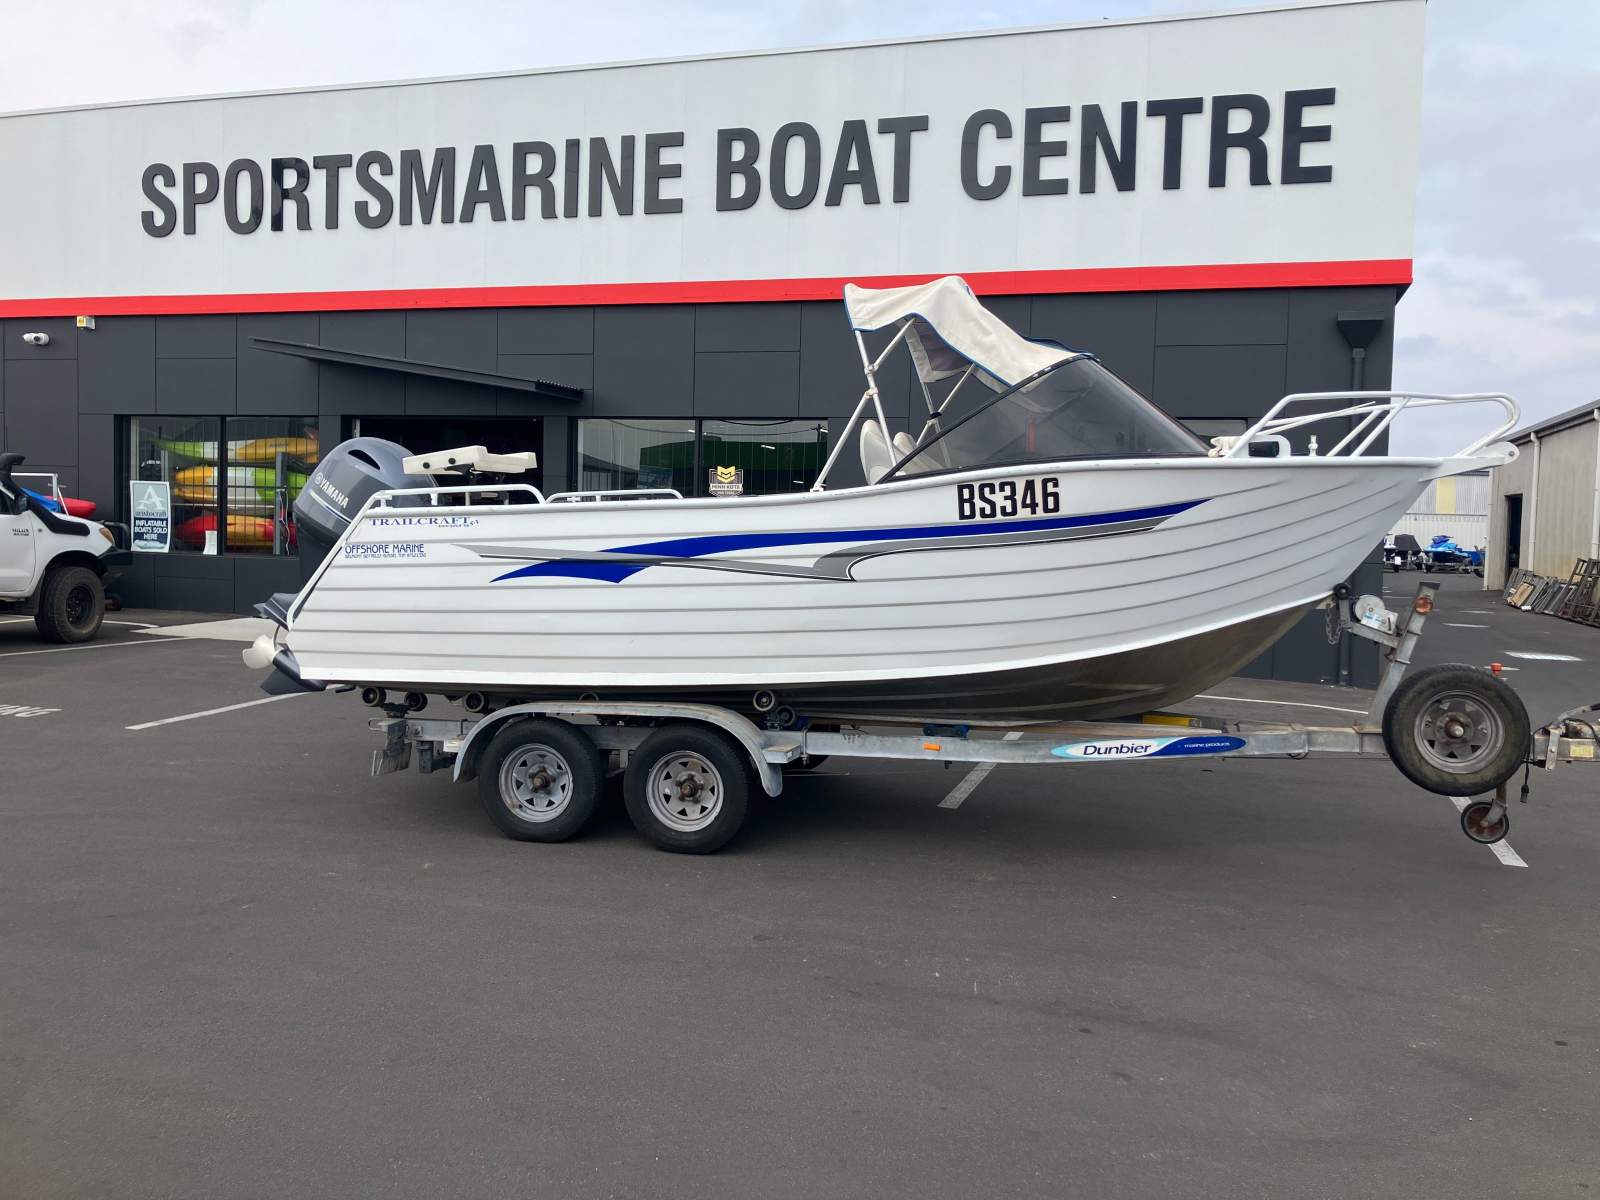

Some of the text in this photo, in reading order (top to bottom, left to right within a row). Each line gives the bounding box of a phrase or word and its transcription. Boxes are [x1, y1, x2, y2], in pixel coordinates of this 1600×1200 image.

[141, 87, 1337, 238] SPORTSMARINE BOAT CENTRE
[319, 479, 349, 509] YAMAHA
[957, 477, 1060, 520] BS346
[371, 516, 470, 526] TRAILCRAFT
[345, 543, 425, 554] OFFSHORE MARINE
[1083, 743, 1151, 756] Dunbier
